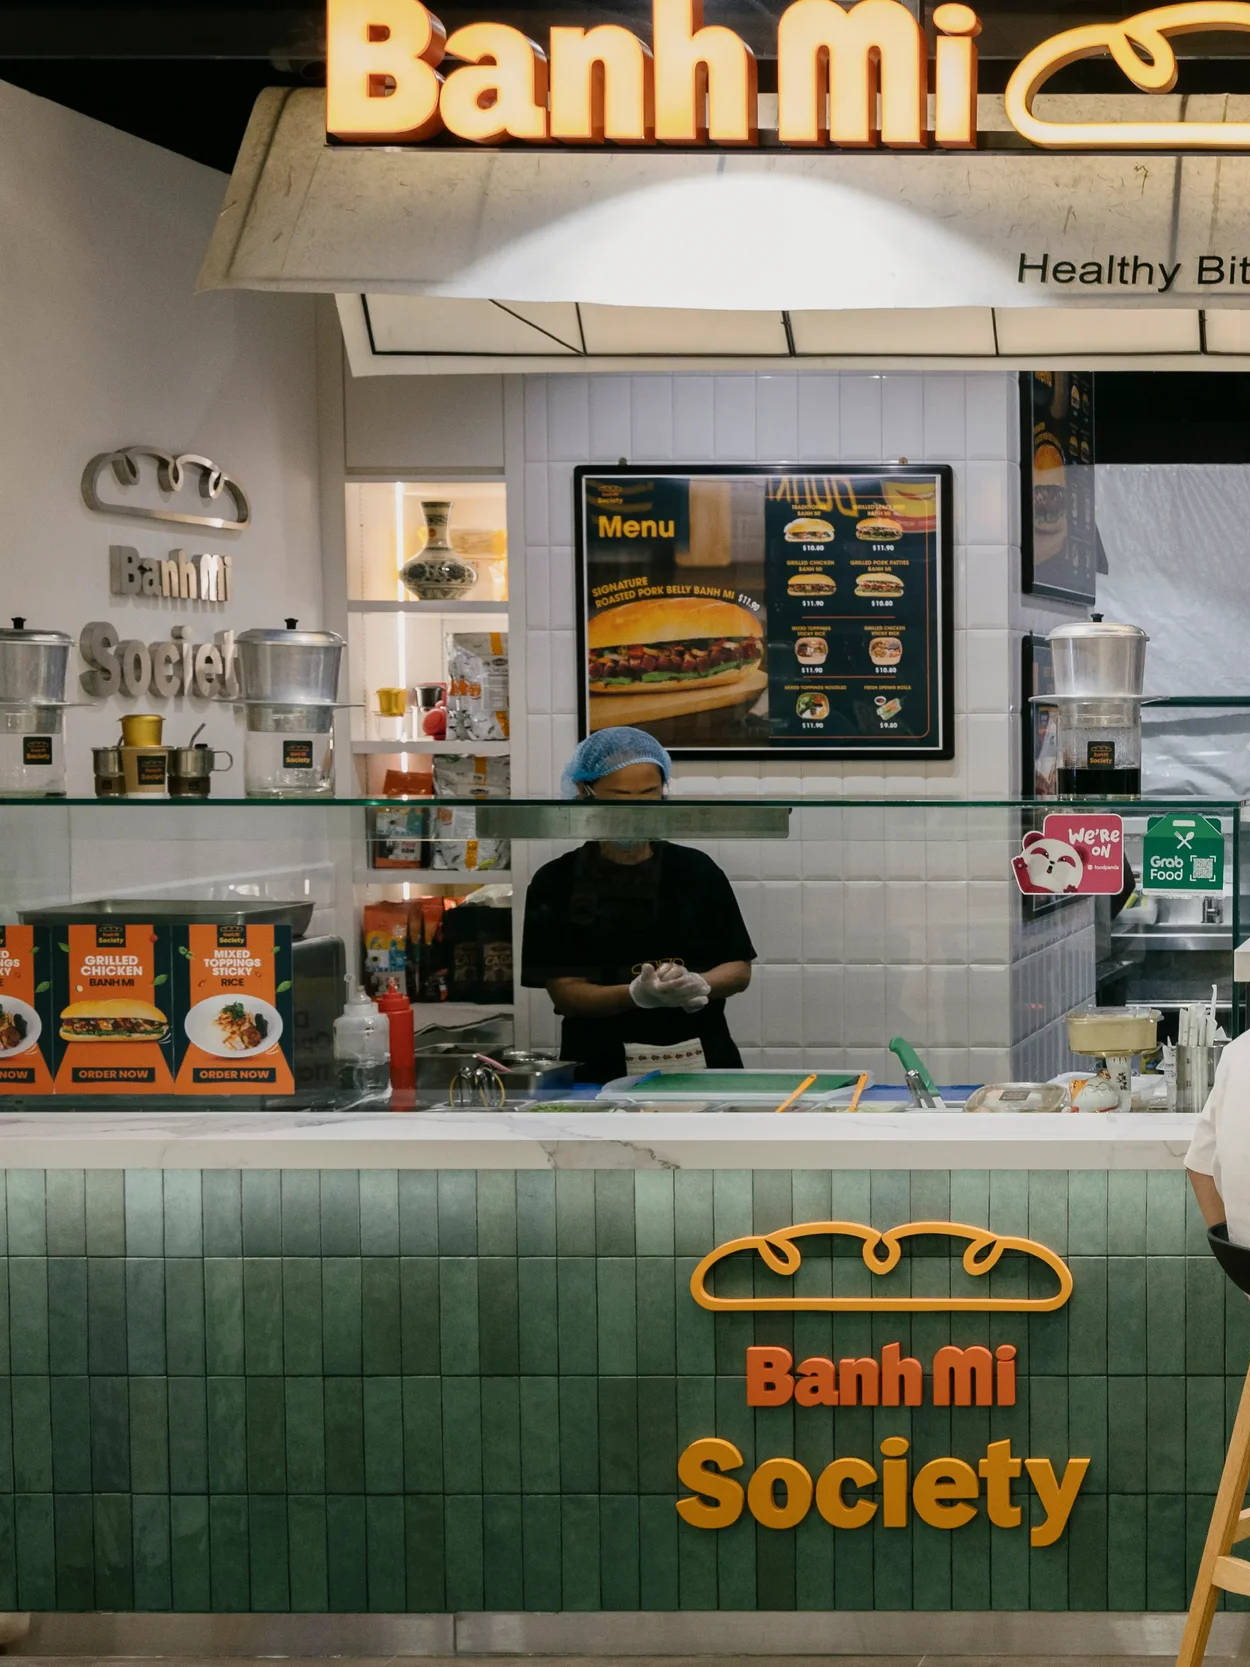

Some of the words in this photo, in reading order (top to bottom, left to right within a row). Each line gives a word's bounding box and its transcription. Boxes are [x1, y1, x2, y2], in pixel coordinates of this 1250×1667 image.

[325, 0, 758, 146] Banh
[776, 0, 981, 150] Mi
[1017, 252, 1180, 292] Healthy
[598, 515, 675, 538] Menu
[872, 544, 895, 552] $11.90
[109, 545, 198, 600] Banh
[198, 553, 233, 601] Mi
[592, 576, 648, 597] SIGNATURE
[595, 590, 636, 608] ROASTED
[638, 586, 664, 597] PORK
[666, 585, 692, 594] BELLY
[722, 589, 736, 600] MI
[737, 593, 761, 612] $11.90
[79, 621, 241, 698] Societ
[1089, 757, 1113, 765] Society
[1150, 855, 1184, 868] Grab
[1150, 869, 1183, 881] Food
[98, 937, 125, 945] Society
[219, 937, 245, 945] Society
[214, 950, 251, 959] MIXED
[85, 955, 139, 966] GRILLED
[204, 959, 262, 967] TOPPINGS
[80, 966, 143, 976] CHICKEN
[212, 968, 253, 976] STICKY
[89, 979, 120, 987] BANH
[121, 979, 135, 987] MI
[221, 979, 245, 987] RICE
[79, 1070, 117, 1079] ORDER
[119, 1070, 149, 1079] NOW
[200, 1070, 238, 1079] ORDER
[239, 1070, 270, 1079] NOW
[747, 1342, 923, 1407] Banh
[933, 1344, 1017, 1407] Mi
[675, 1436, 1091, 1548] Society
